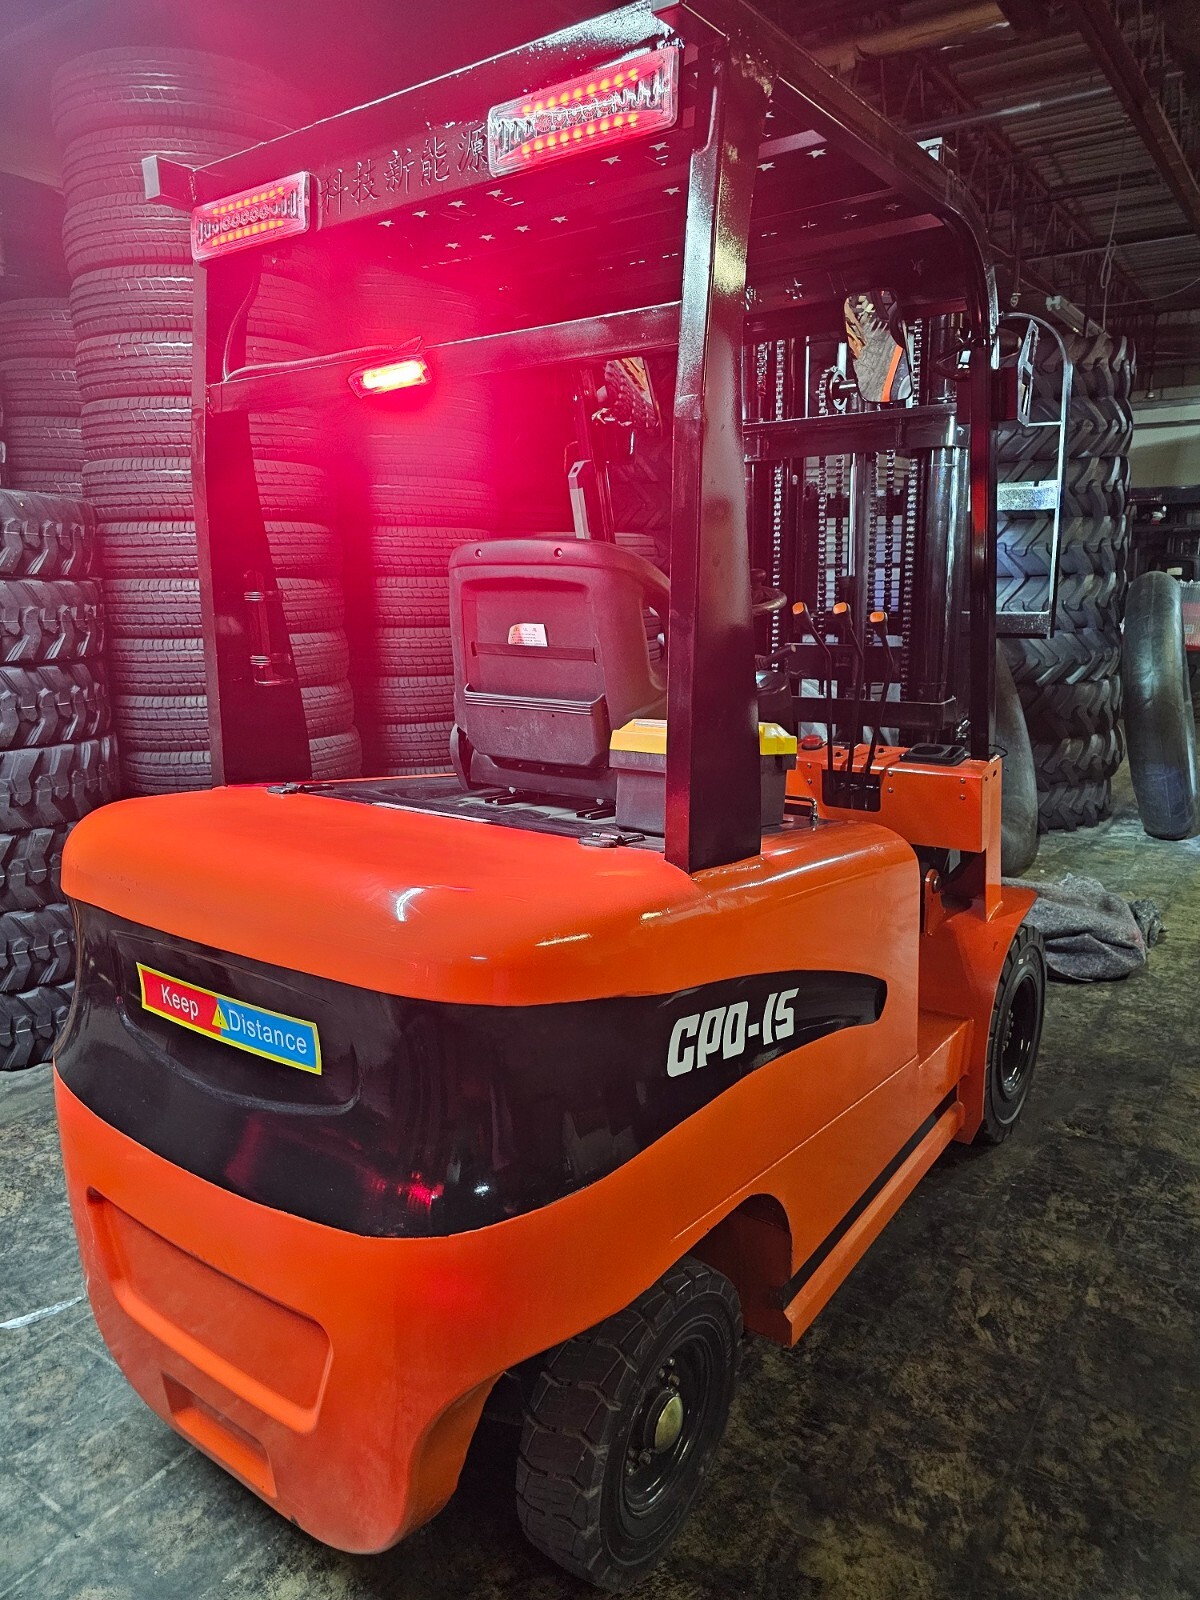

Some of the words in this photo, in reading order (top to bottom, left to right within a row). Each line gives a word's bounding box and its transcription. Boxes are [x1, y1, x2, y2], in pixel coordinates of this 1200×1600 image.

[320, 123, 488, 215] 科技新能源
[160, 984, 199, 1020] Keep
[228, 1009, 307, 1055] Distance
